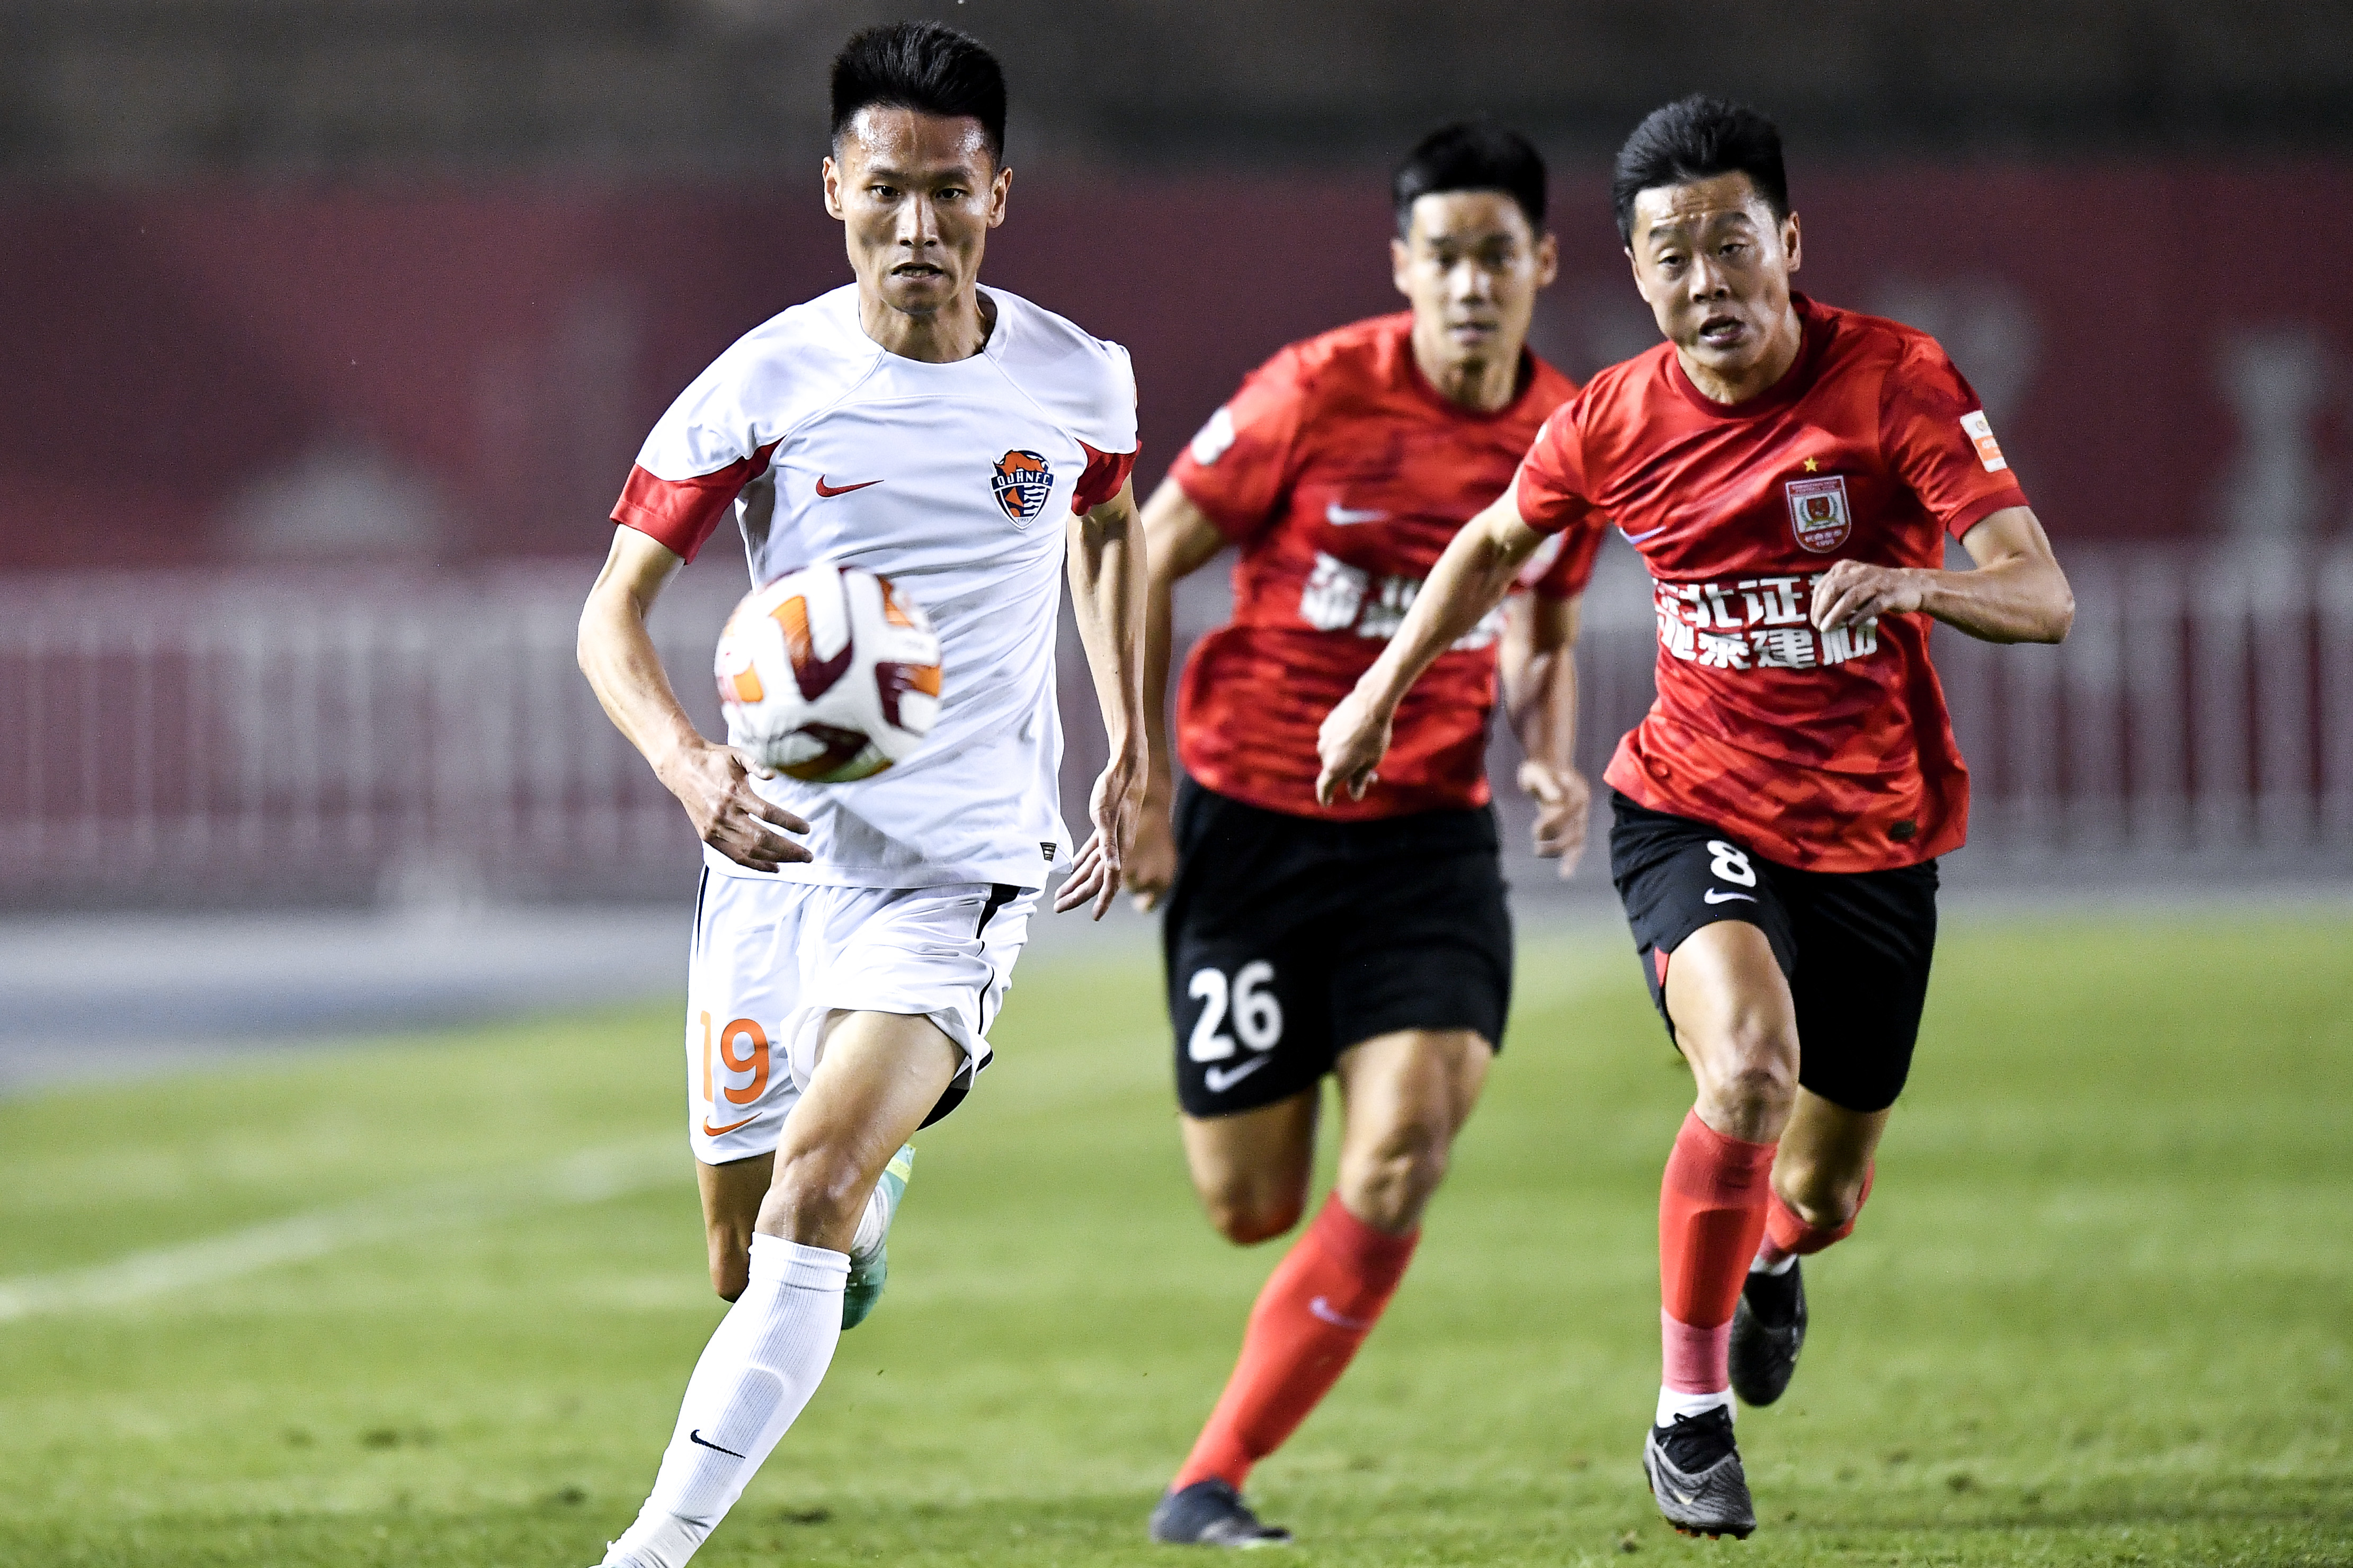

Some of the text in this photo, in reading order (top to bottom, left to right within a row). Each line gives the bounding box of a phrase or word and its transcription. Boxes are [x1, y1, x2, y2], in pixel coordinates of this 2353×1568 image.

[1707, 840, 1757, 888] 8
[700, 1010, 770, 1105] 19
[1188, 960, 1284, 1062] 26
